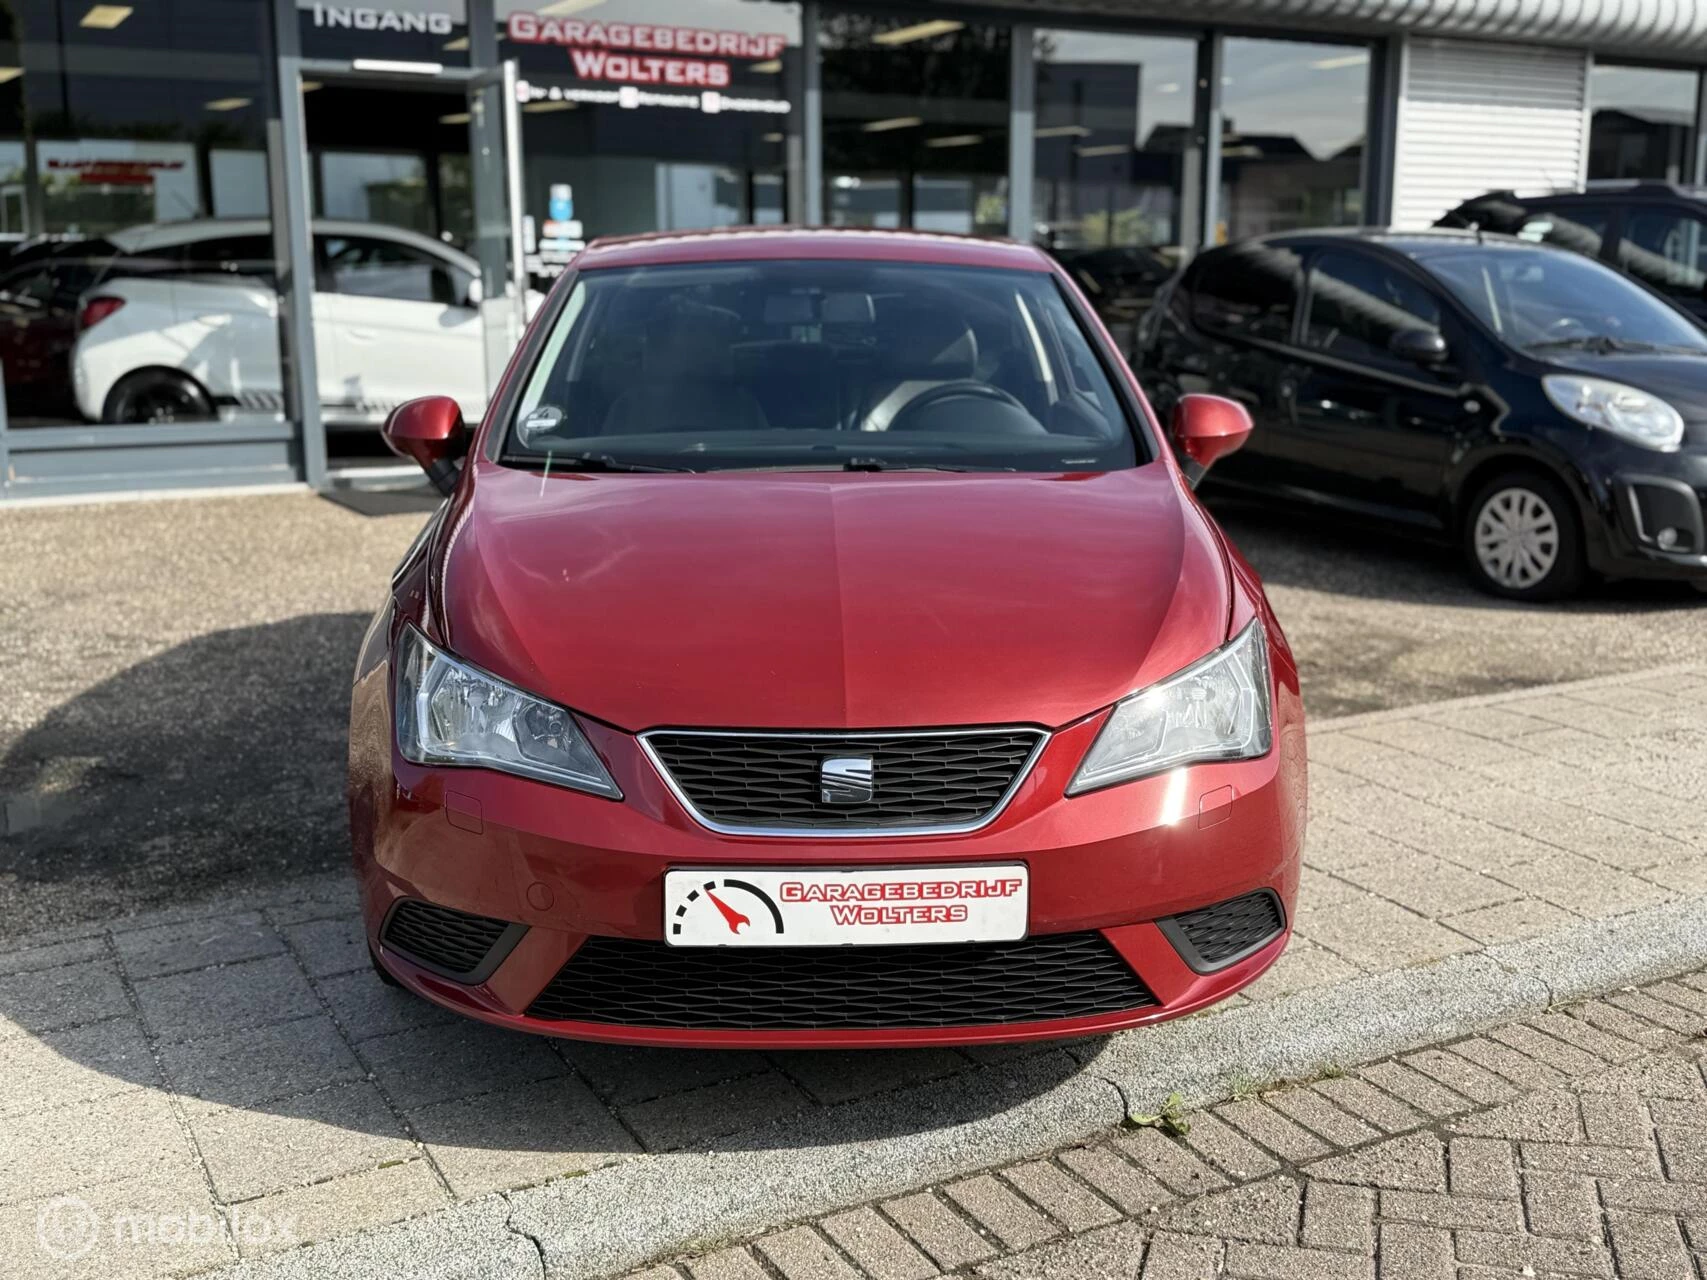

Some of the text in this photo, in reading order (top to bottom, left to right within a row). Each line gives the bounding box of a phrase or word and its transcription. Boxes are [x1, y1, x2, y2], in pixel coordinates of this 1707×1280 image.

[313, 2, 452, 34] INGANG
[508, 11, 787, 57] GARAGEBEDRIJF
[569, 48, 730, 86] WOLTERS
[780, 879, 1022, 902] GARAGEBEDRIJF
[830, 904, 967, 925] WOLTERS
